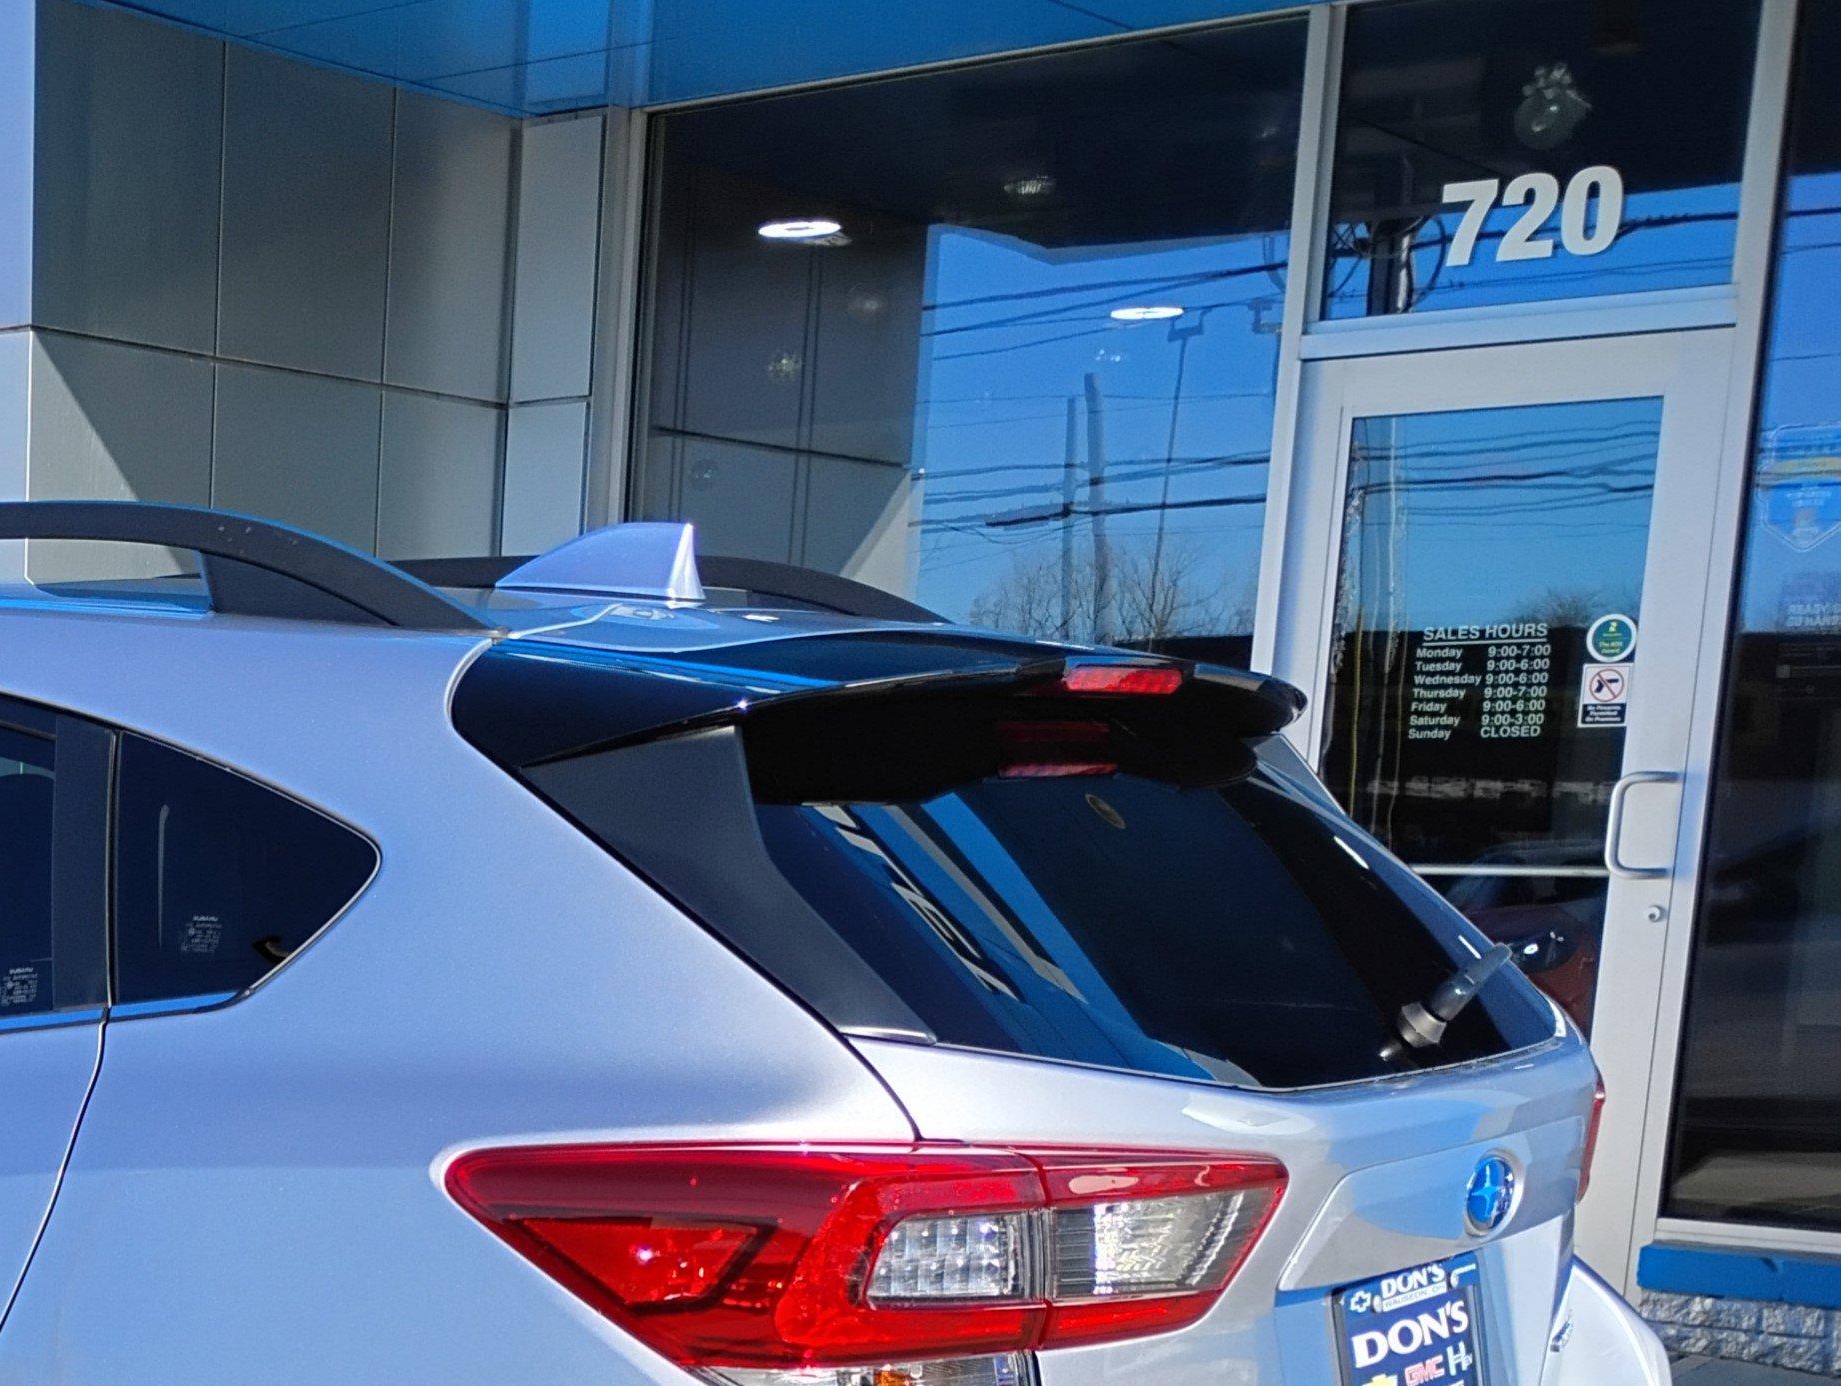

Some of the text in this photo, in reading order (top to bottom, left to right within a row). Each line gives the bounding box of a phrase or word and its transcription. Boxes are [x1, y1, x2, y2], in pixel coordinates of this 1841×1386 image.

[1442, 165, 1623, 266] 720
[1423, 623, 1548, 640] SALES HOURS
[1416, 645, 1550, 660] Monday 9:00-7:00
[1415, 658, 1549, 673] Tuesday 9:00-6:00
[1414, 673, 1548, 686] Wednesday 9:00-6:00
[1413, 686, 1547, 700] Thursday 9:00-7:00
[1411, 700, 1545, 714] Friday 9:00-6:00
[1409, 713, 1544, 727] Saturday 9:00-3:00
[1408, 726, 1540, 741] Sunday CLOSED
[1381, 1263, 1446, 1298] DON'S
[1351, 1300, 1469, 1368] DON'S
